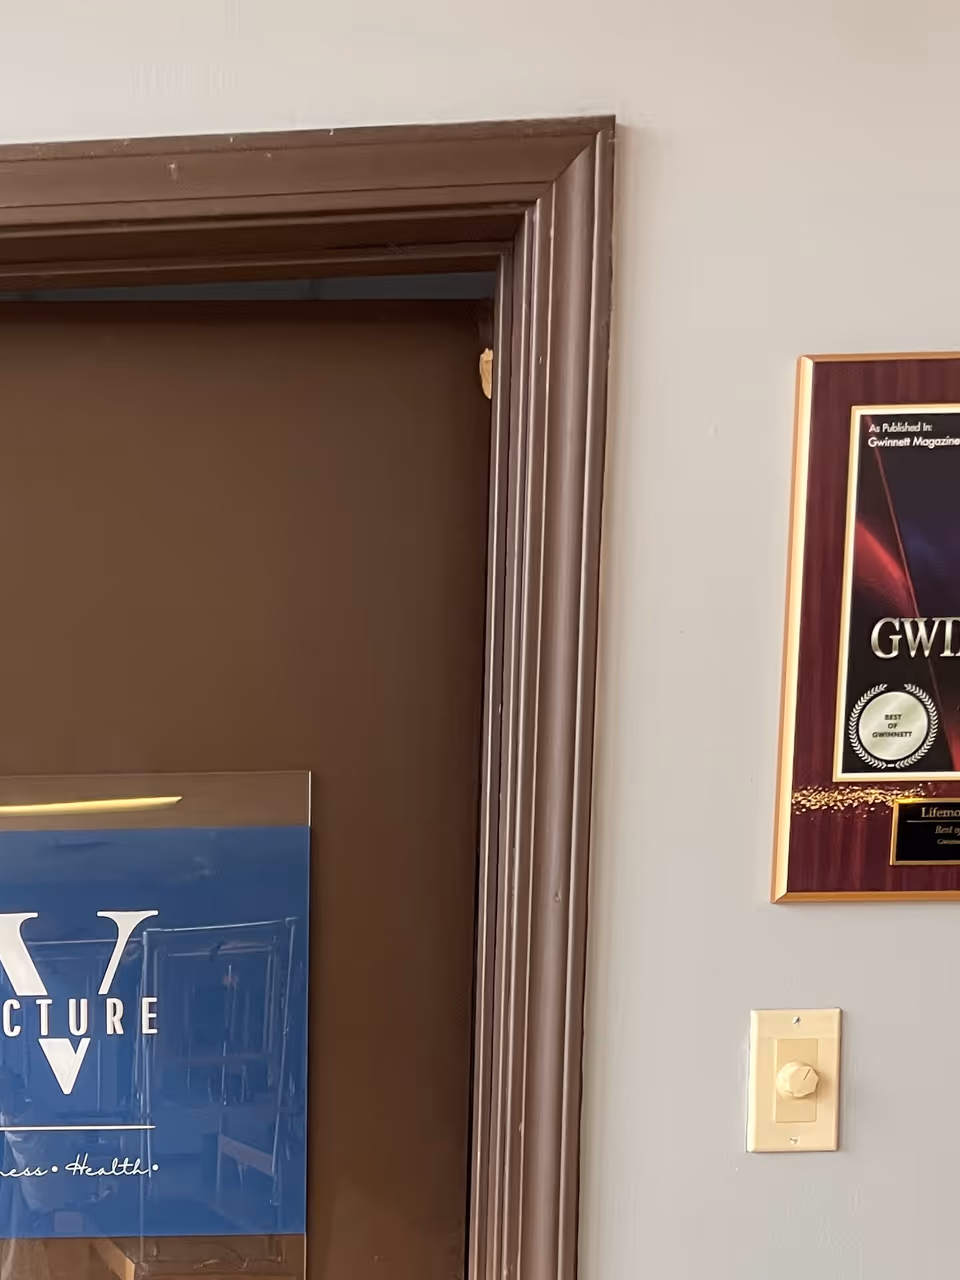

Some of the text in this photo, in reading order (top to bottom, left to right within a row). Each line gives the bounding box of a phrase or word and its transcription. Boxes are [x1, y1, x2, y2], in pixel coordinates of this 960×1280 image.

[869, 421, 932, 432] As Published In:
[868, 436, 960, 448] Gwinnett Magazine
[870, 616, 960, 659] GWI
[64, 1153, 150, 1178] Health
